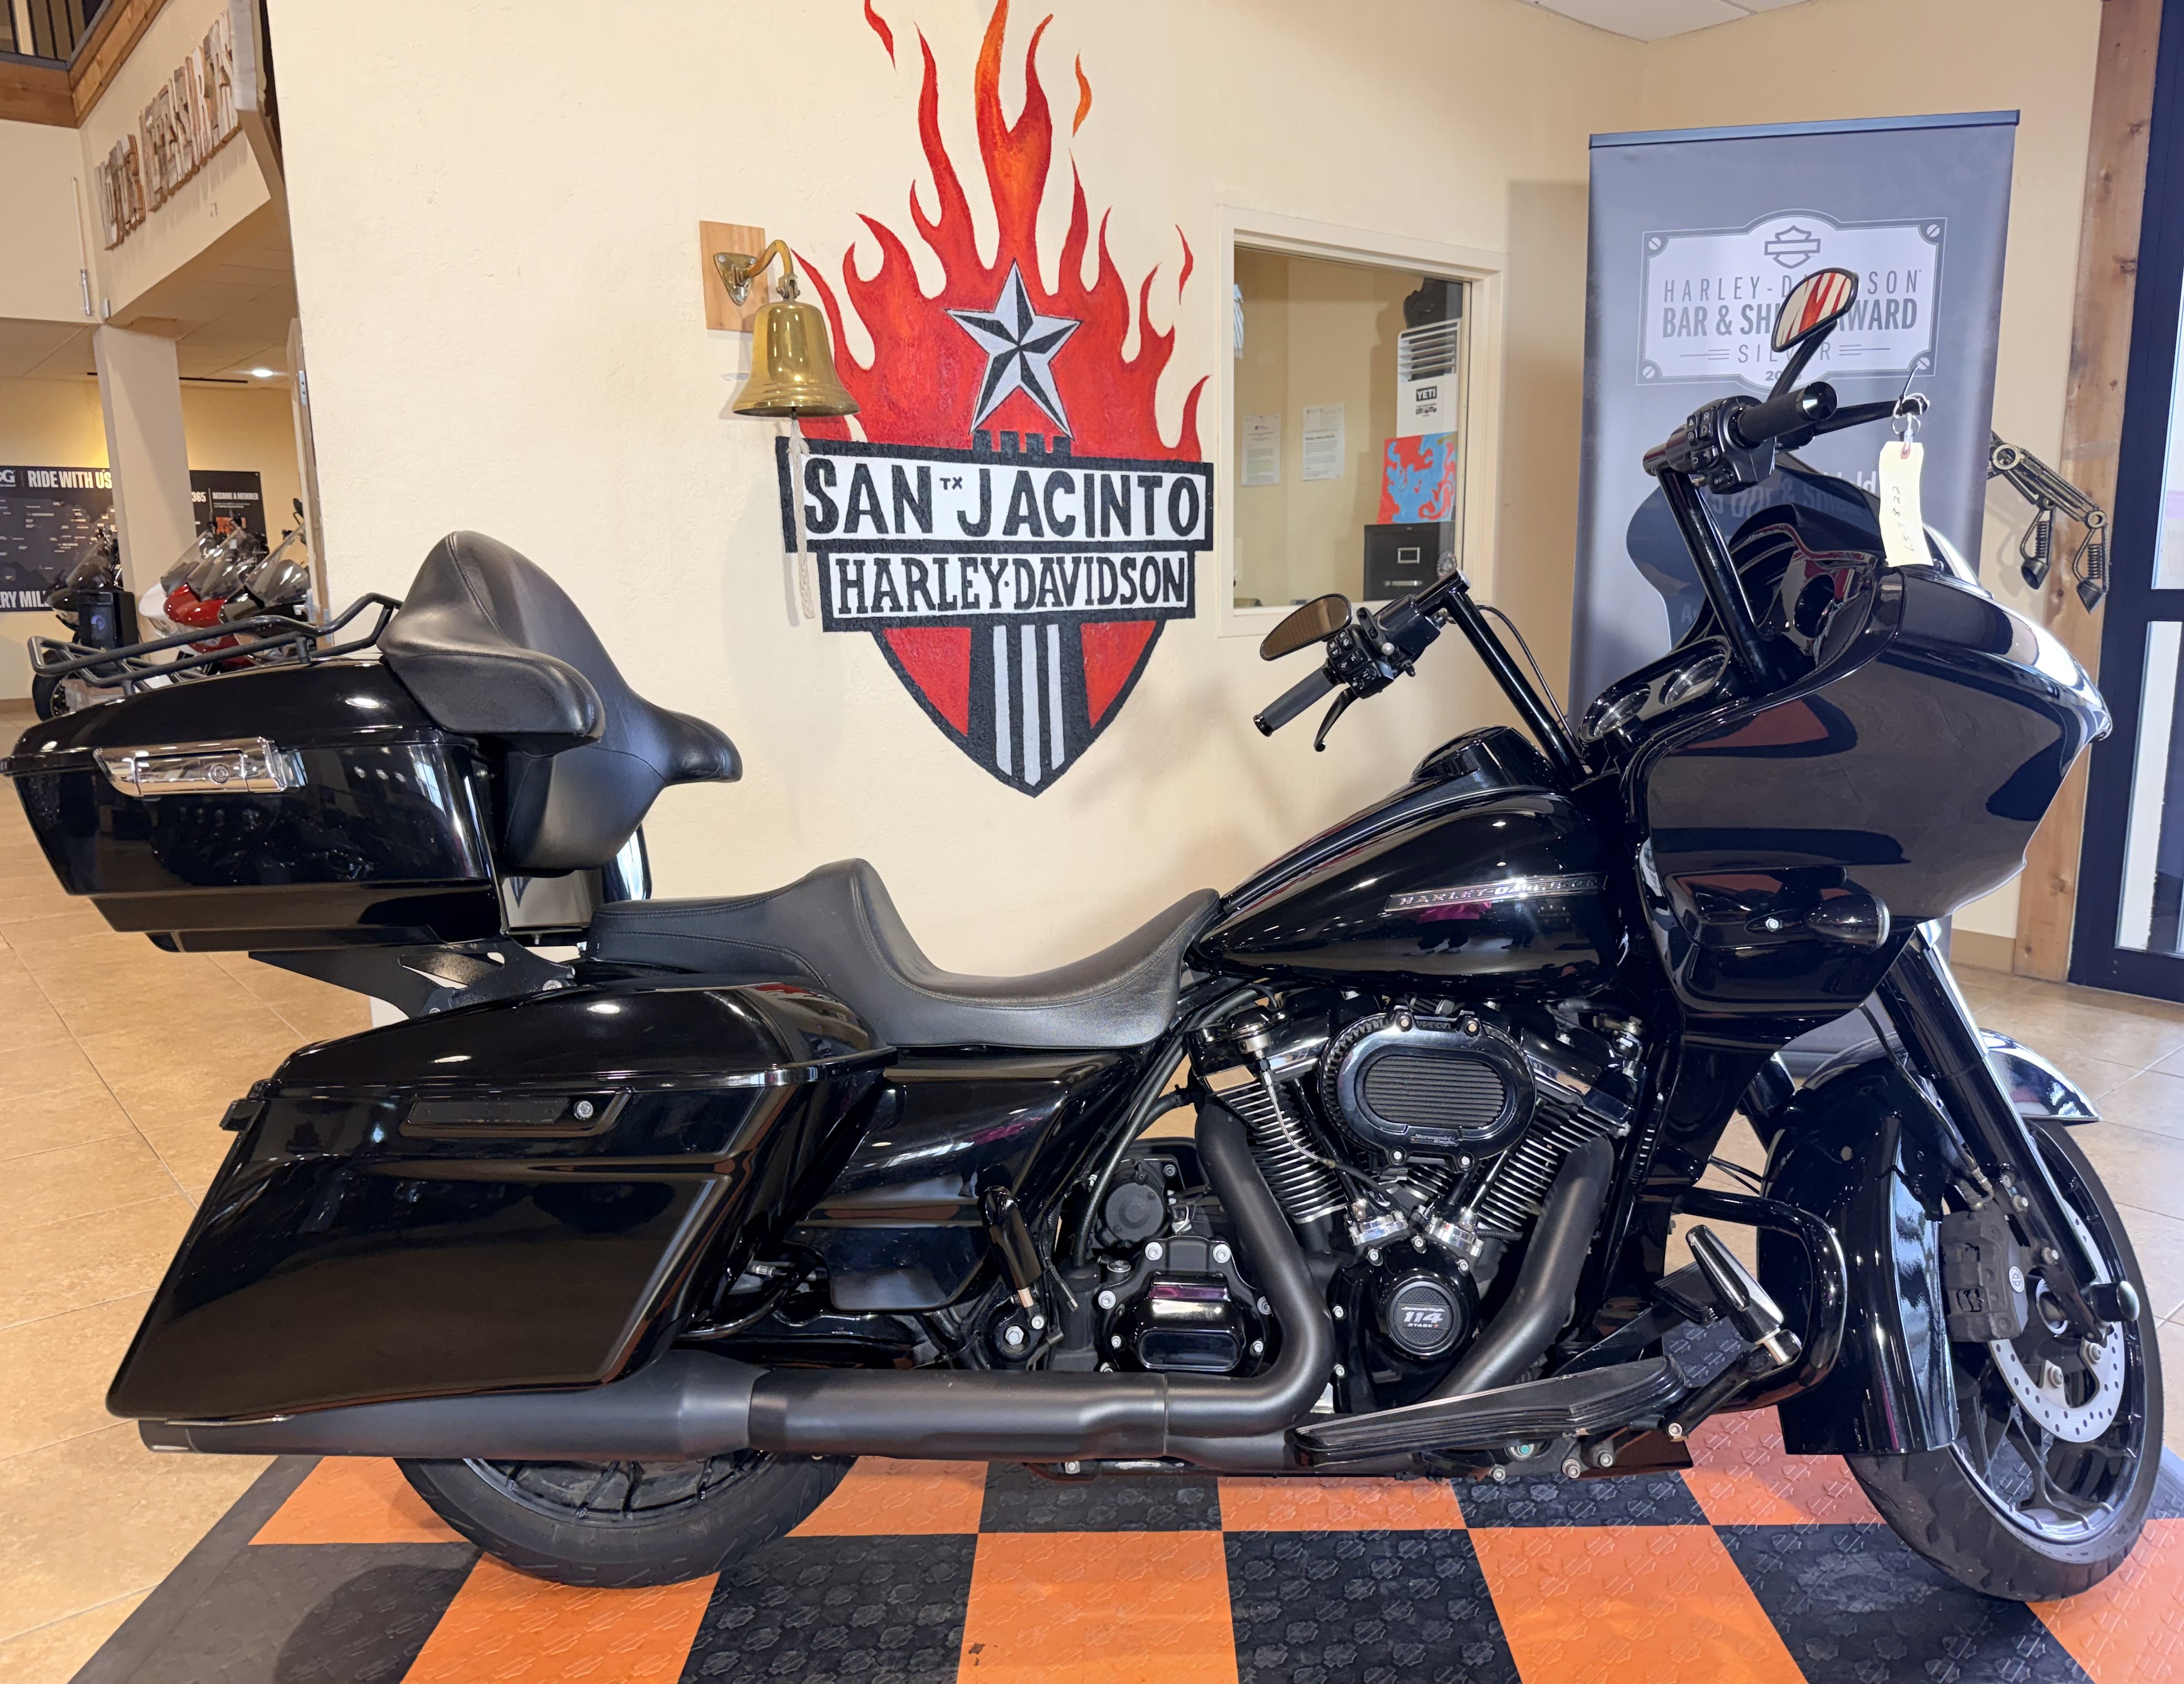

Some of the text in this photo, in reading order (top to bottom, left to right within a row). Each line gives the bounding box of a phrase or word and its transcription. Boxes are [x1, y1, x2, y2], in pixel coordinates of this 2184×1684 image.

[1664, 270, 1919, 302] HARLEY-DSON
[1662, 306, 1708, 338] BAR
[1716, 305, 1732, 335] &
[1738, 342, 1830, 363] SILVR
[1764, 370, 1802, 381] 20
[1417, 388, 1436, 399] YETI
[28, 471, 112, 489] RIDE WITH US
[939, 477, 963, 490] TX
[191, 491, 207, 502] 365
[212, 492, 233, 500] BECOME
[804, 458, 933, 534] SAN
[957, 468, 1199, 537] JACINTO
[0, 591, 17, 609] RY
[1403, 1311, 1443, 1323] 114
